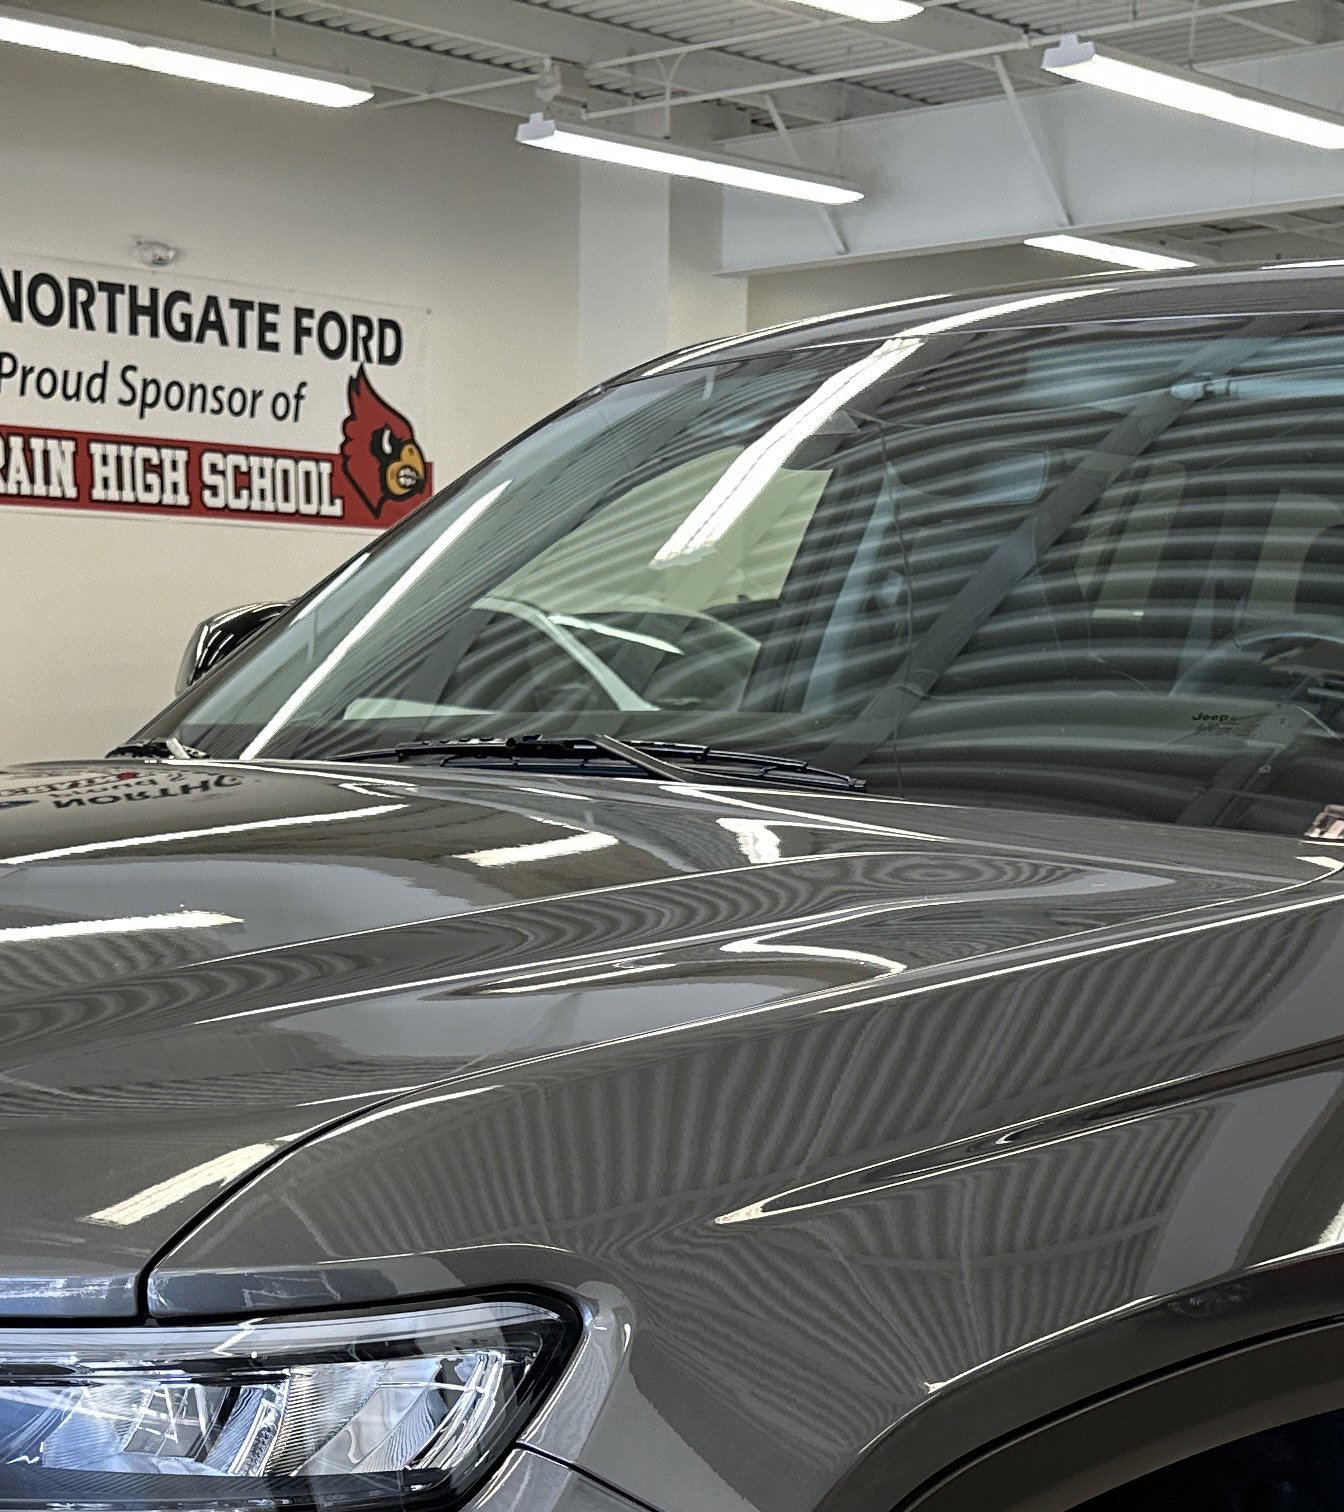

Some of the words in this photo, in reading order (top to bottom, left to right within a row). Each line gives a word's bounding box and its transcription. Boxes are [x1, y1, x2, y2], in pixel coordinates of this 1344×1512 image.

[293, 305, 403, 367] FORD
[117, 364, 264, 419] Sponsor
[270, 381, 308, 423] of
[88, 439, 191, 507] HIGH
[201, 451, 345, 518] SCHOOL
